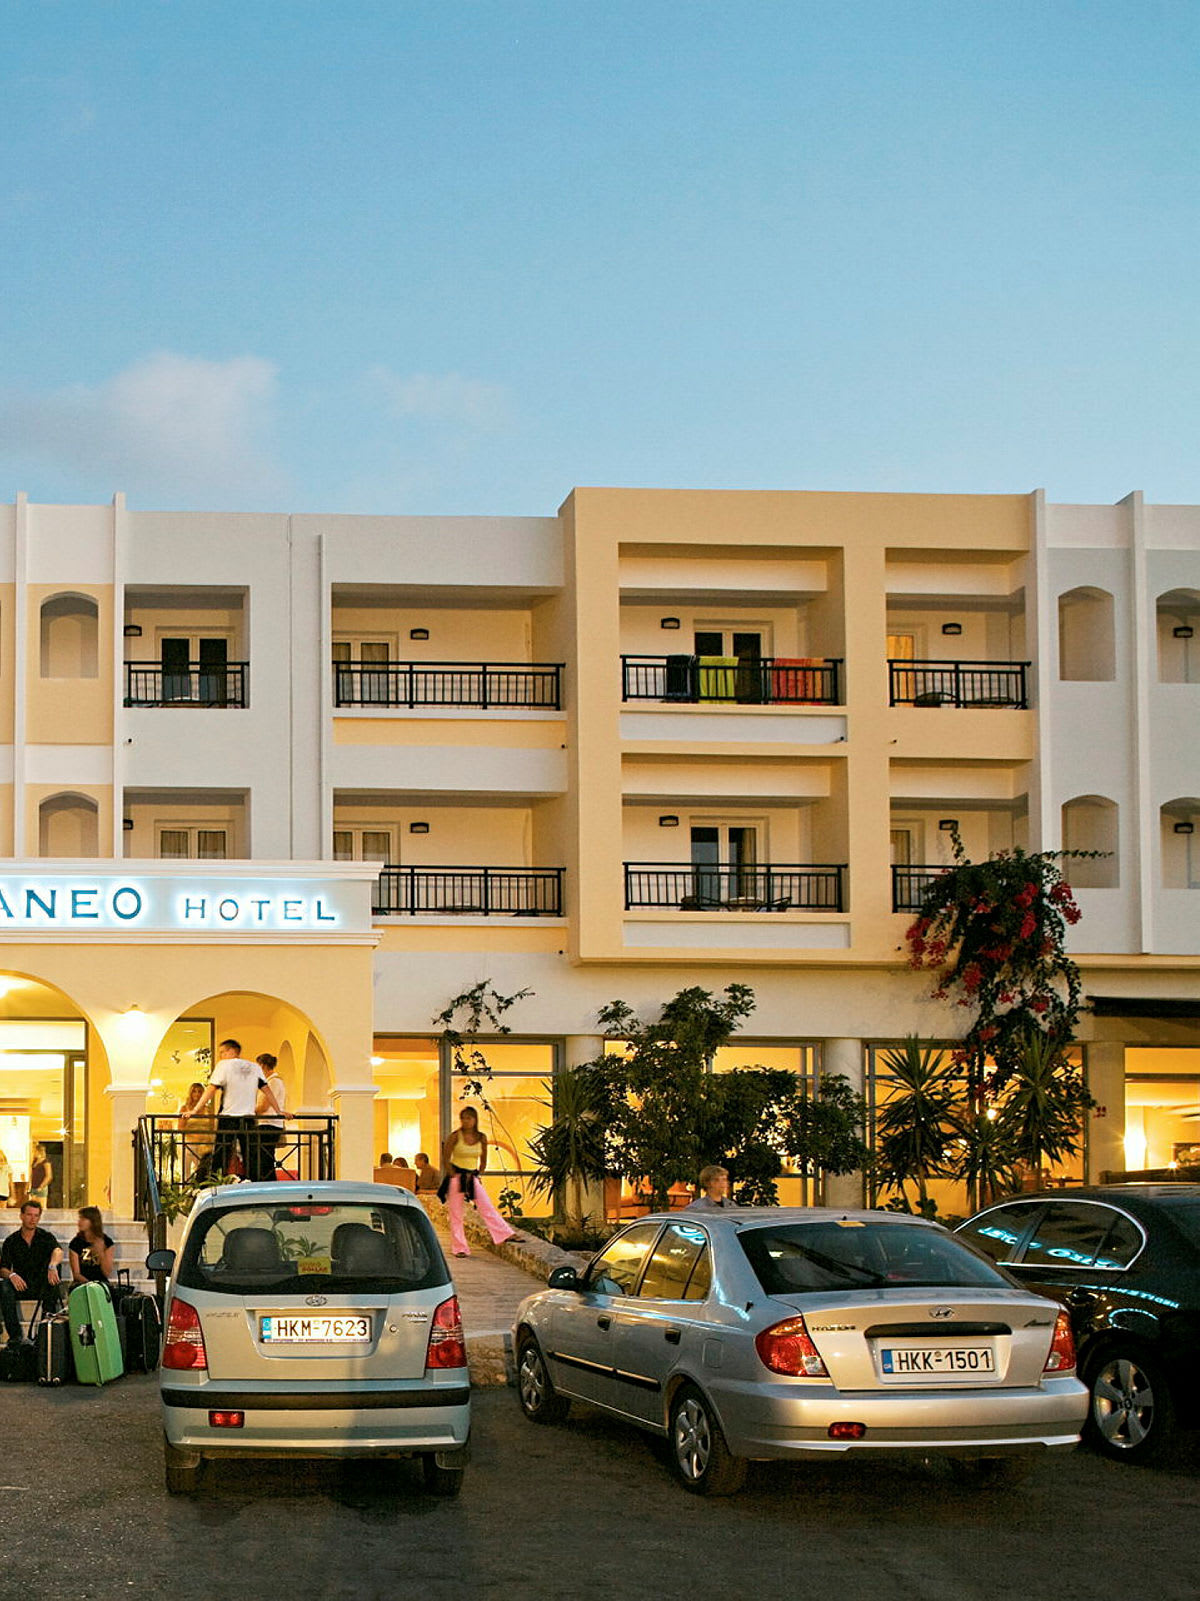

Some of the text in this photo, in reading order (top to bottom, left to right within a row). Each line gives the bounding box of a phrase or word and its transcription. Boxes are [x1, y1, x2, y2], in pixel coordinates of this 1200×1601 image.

[184, 898, 335, 921] HOTEL
[277, 1320, 367, 1337] HKM-7623
[898, 1350, 990, 1370] HKK-1501
